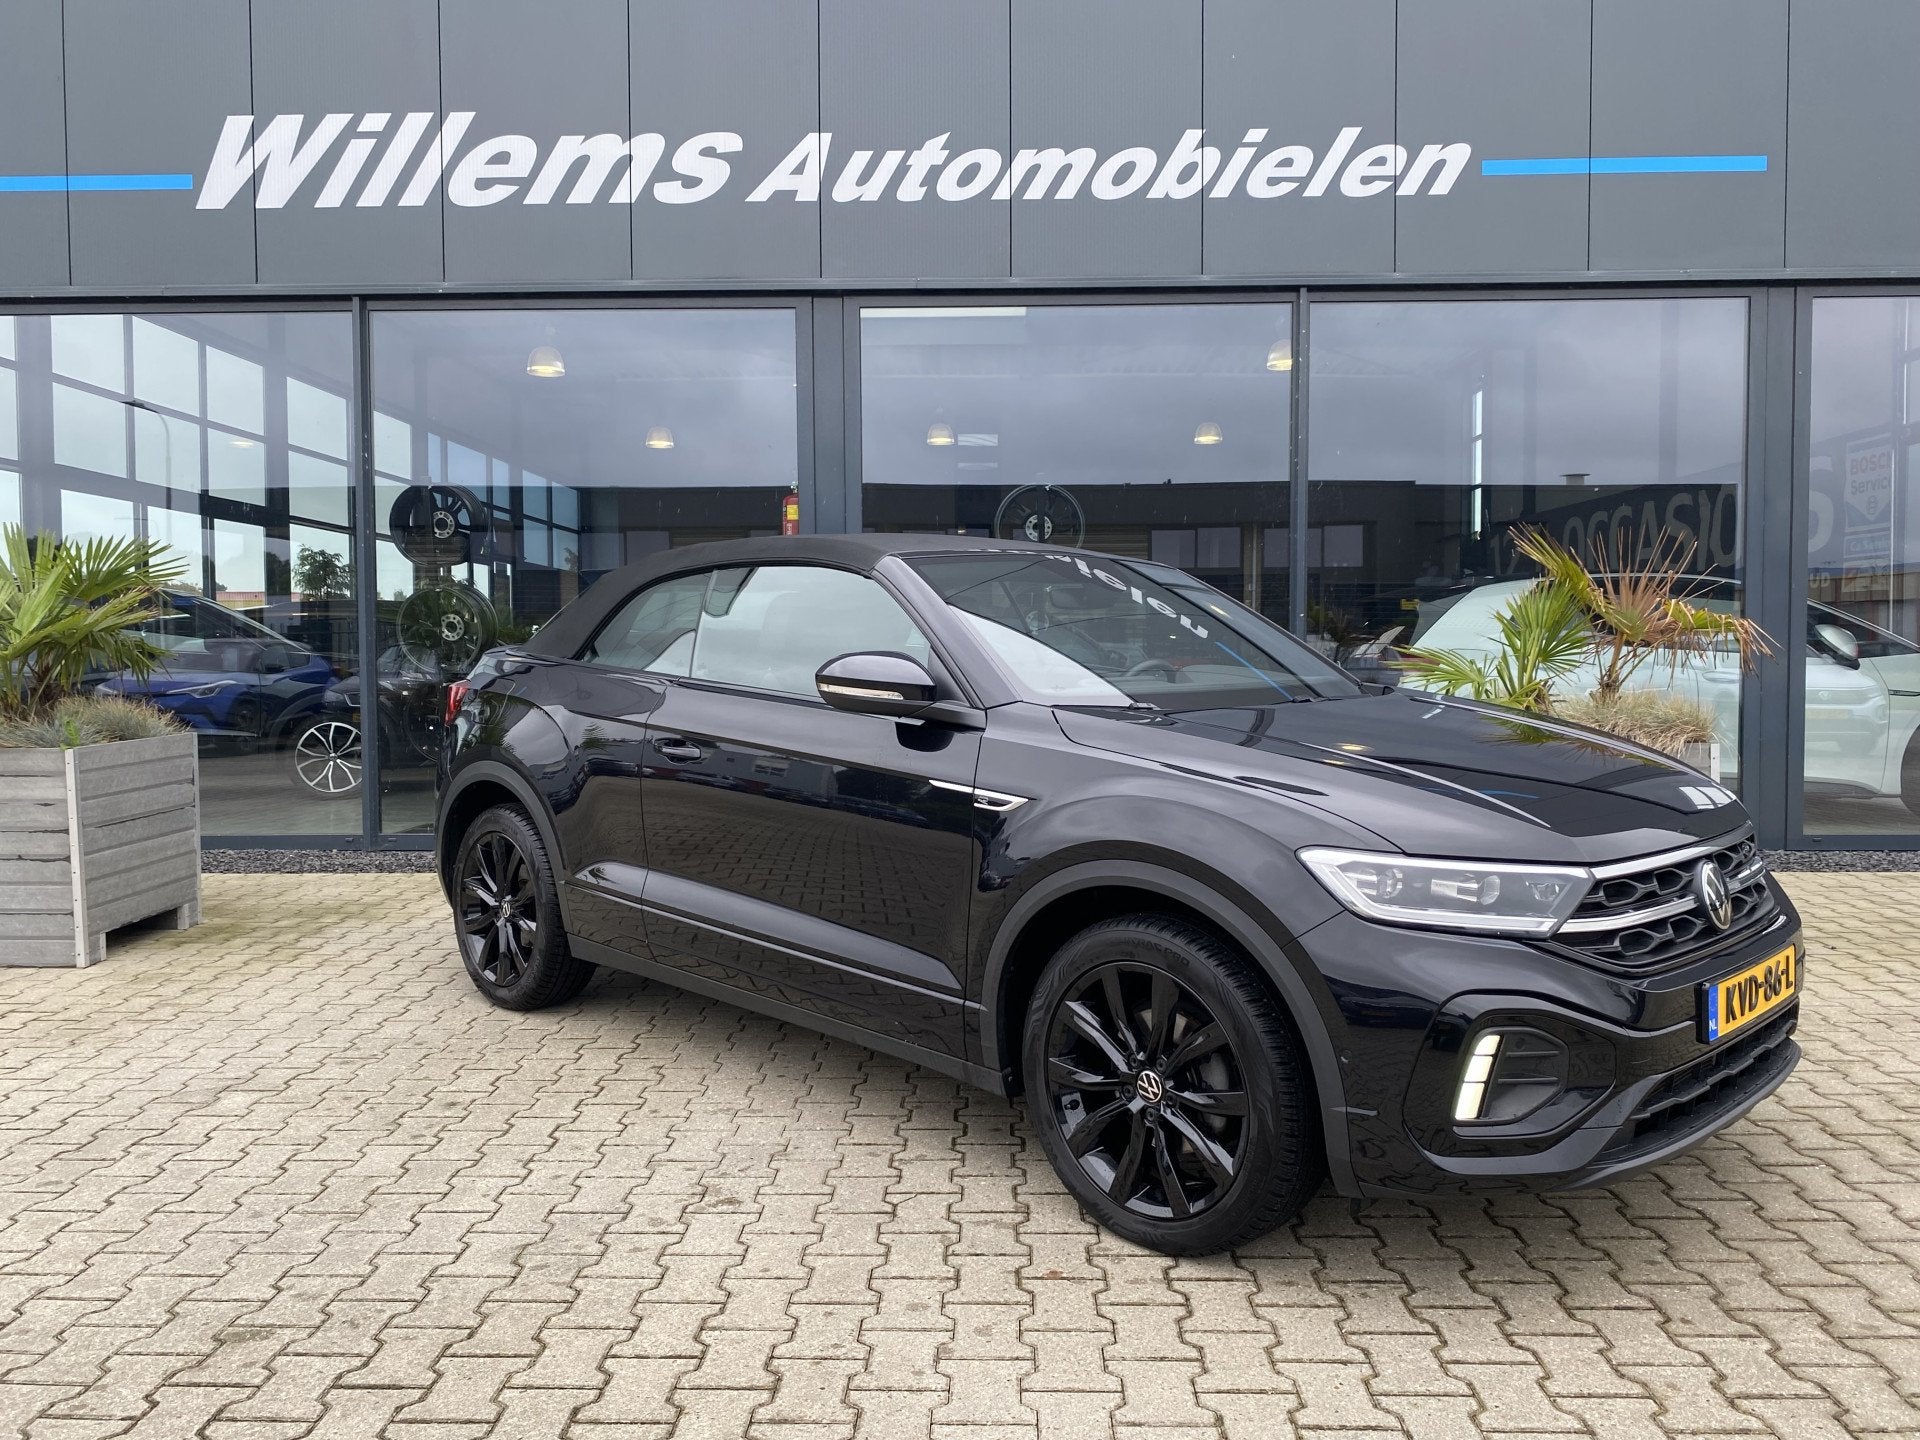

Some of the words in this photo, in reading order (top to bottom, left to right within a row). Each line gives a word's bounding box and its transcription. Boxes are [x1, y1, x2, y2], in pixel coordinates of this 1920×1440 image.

[195, 111, 744, 209] Willems
[744, 126, 1472, 202] Automobielen
[1709, 1018, 1718, 1032] NL
[1726, 955, 1793, 1025] KVD-86-L
